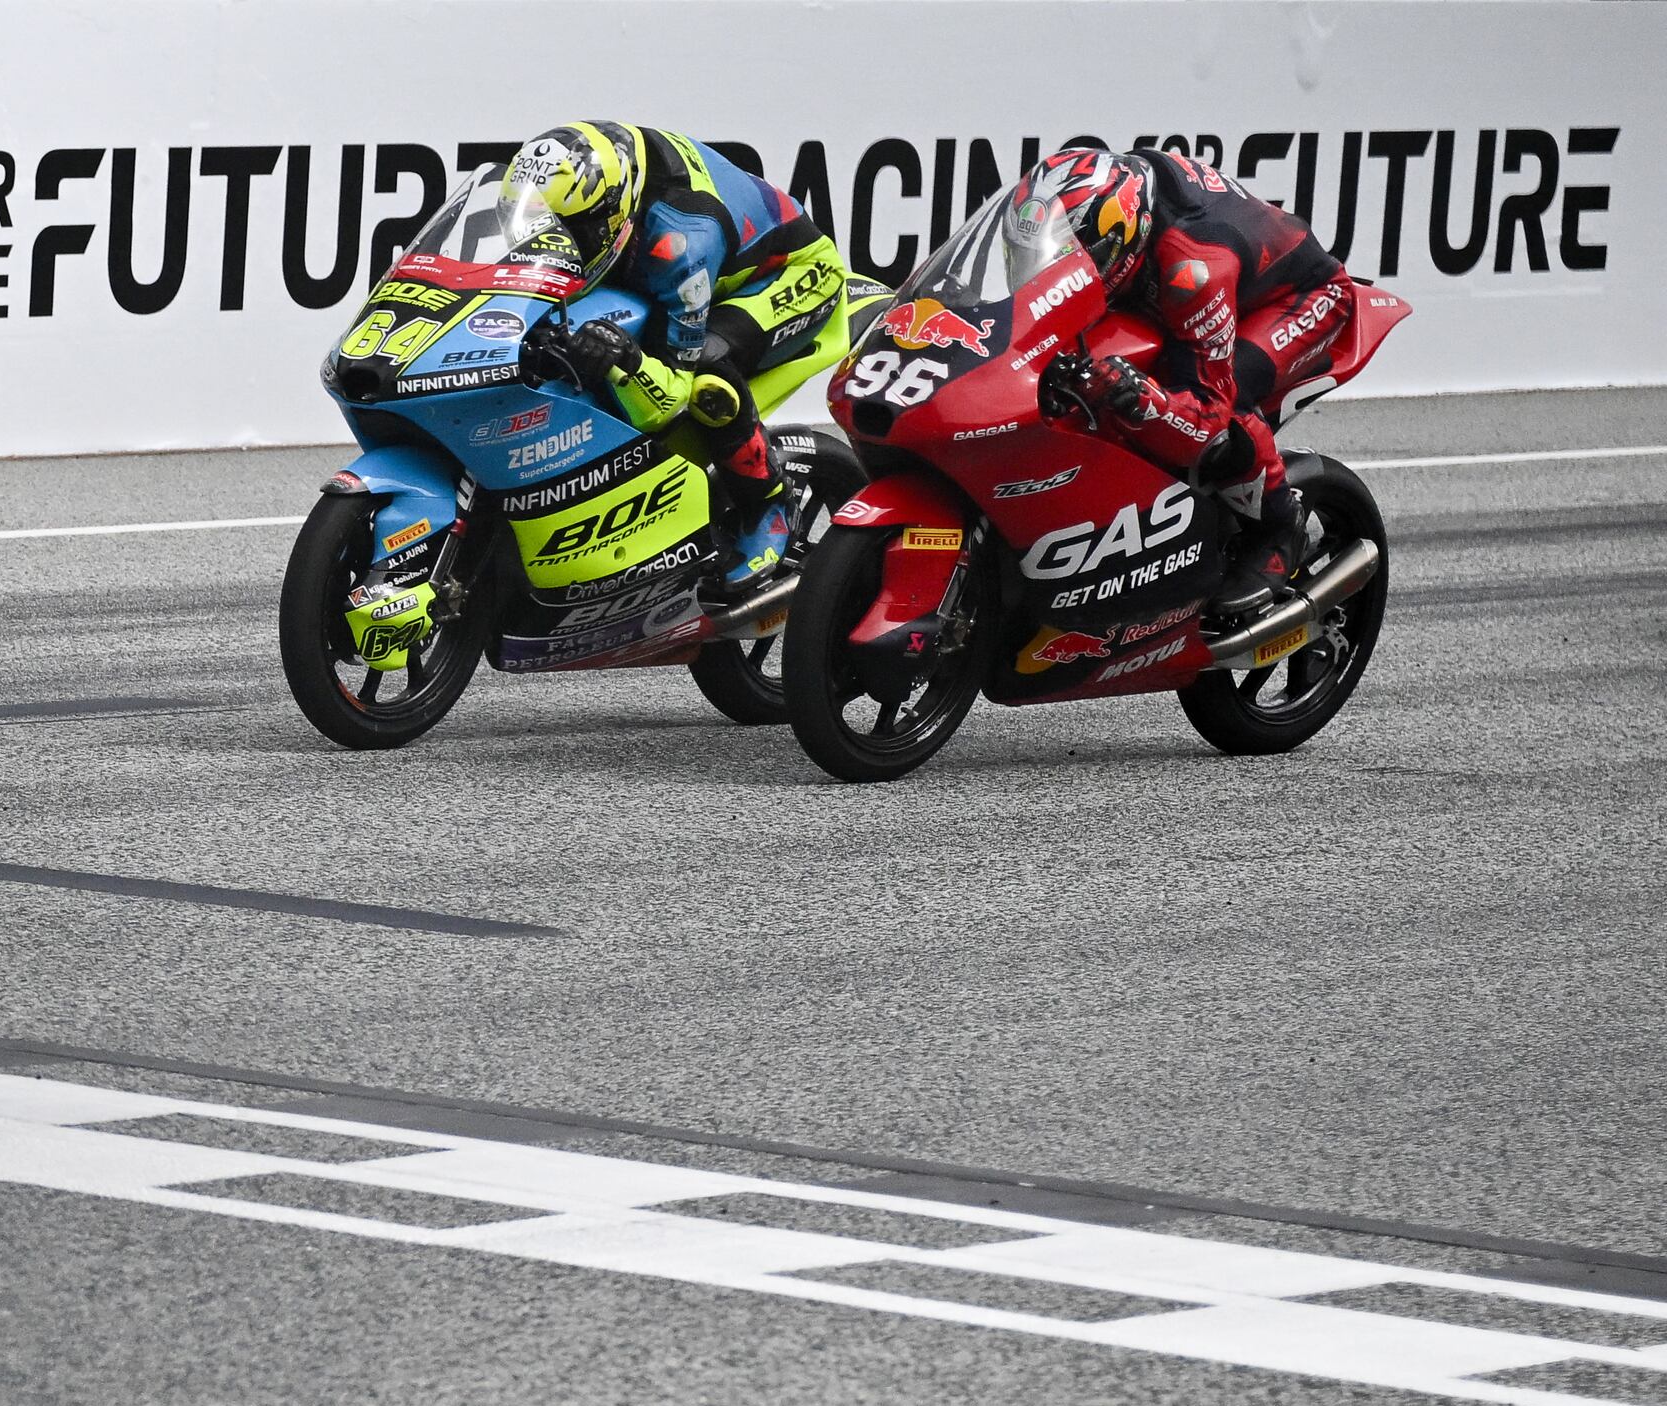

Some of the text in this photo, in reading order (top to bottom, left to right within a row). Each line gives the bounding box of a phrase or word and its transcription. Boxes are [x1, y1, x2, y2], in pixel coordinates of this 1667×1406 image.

[510, 170, 547, 186] GRUP
[514, 157, 554, 175] PONT
[531, 242, 579, 256] OAKLEY
[492, 279, 567, 296] HELMETS
[494, 268, 571, 287] LS2
[377, 281, 463, 311] BOE
[1028, 267, 1094, 321] MOTUL
[1184, 287, 1226, 331] DAINESE
[473, 318, 520, 327] FACE
[1194, 303, 1232, 340] MOTUL
[339, 309, 443, 367] 64
[441, 346, 513, 364] BOE
[397, 364, 519, 394] INFINITUM FEST
[844, 350, 949, 408] 96
[507, 418, 594, 470] ZENDURE
[778, 435, 817, 449] TITAN
[953, 421, 1019, 441] GASGAS
[503, 439, 653, 512] INFINITUM FEST
[785, 460, 813, 474] WRS
[535, 464, 690, 558] BOE
[908, 531, 959, 546] PIRELLI
[1019, 481, 1196, 580] GAS
[566, 542, 700, 601] DriverCarsbcn
[747, 546, 780, 573] 64
[1050, 541, 1203, 609] GET ON THE GAS!
[372, 593, 419, 619] GALFER
[361, 615, 426, 662] 64
[1120, 608, 1167, 646] Red
[1095, 634, 1187, 683] MOTUL
[1259, 627, 1304, 661] PIRELLI
